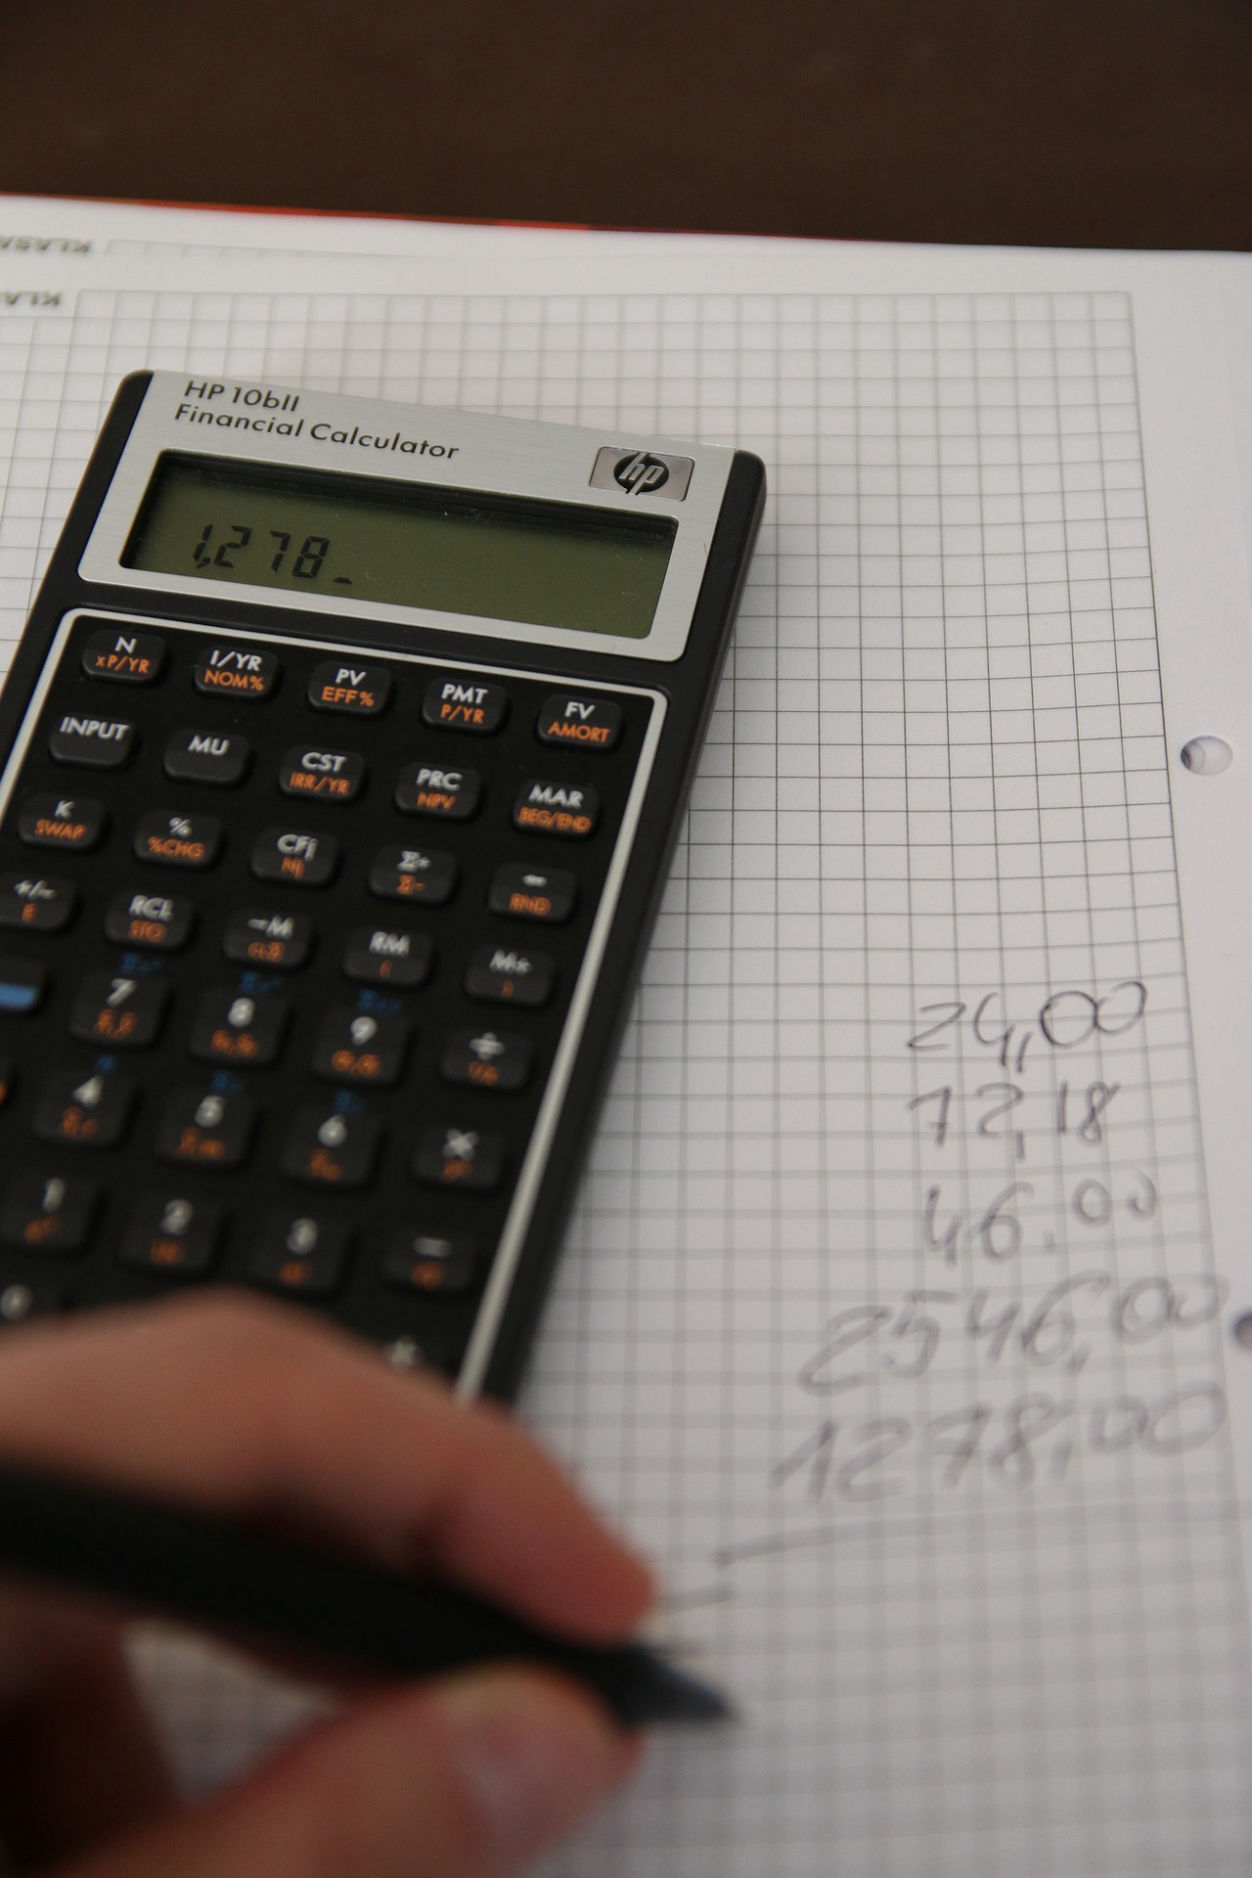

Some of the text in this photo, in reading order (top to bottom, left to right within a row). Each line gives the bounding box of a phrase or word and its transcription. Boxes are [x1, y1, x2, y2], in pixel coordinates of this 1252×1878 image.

[184, 380, 225, 400] HP
[174, 403, 460, 459] Financial Calculator
[115, 637, 137, 654] N
[95, 653, 150, 674] xP/YR
[210, 650, 262, 673] I/YR
[204, 669, 264, 691] NOM%
[335, 668, 367, 686] PV
[321, 686, 375, 706] EFF%
[441, 684, 488, 704] PMT
[440, 704, 485, 724] P/YR
[564, 702, 596, 719] FV
[59, 716, 129, 741] INPUT
[548, 721, 610, 743] AMORT
[187, 735, 230, 756] MU
[301, 751, 347, 773] CST
[416, 768, 463, 791] PRC
[528, 784, 584, 809] MAR
[54, 800, 75, 818] K
